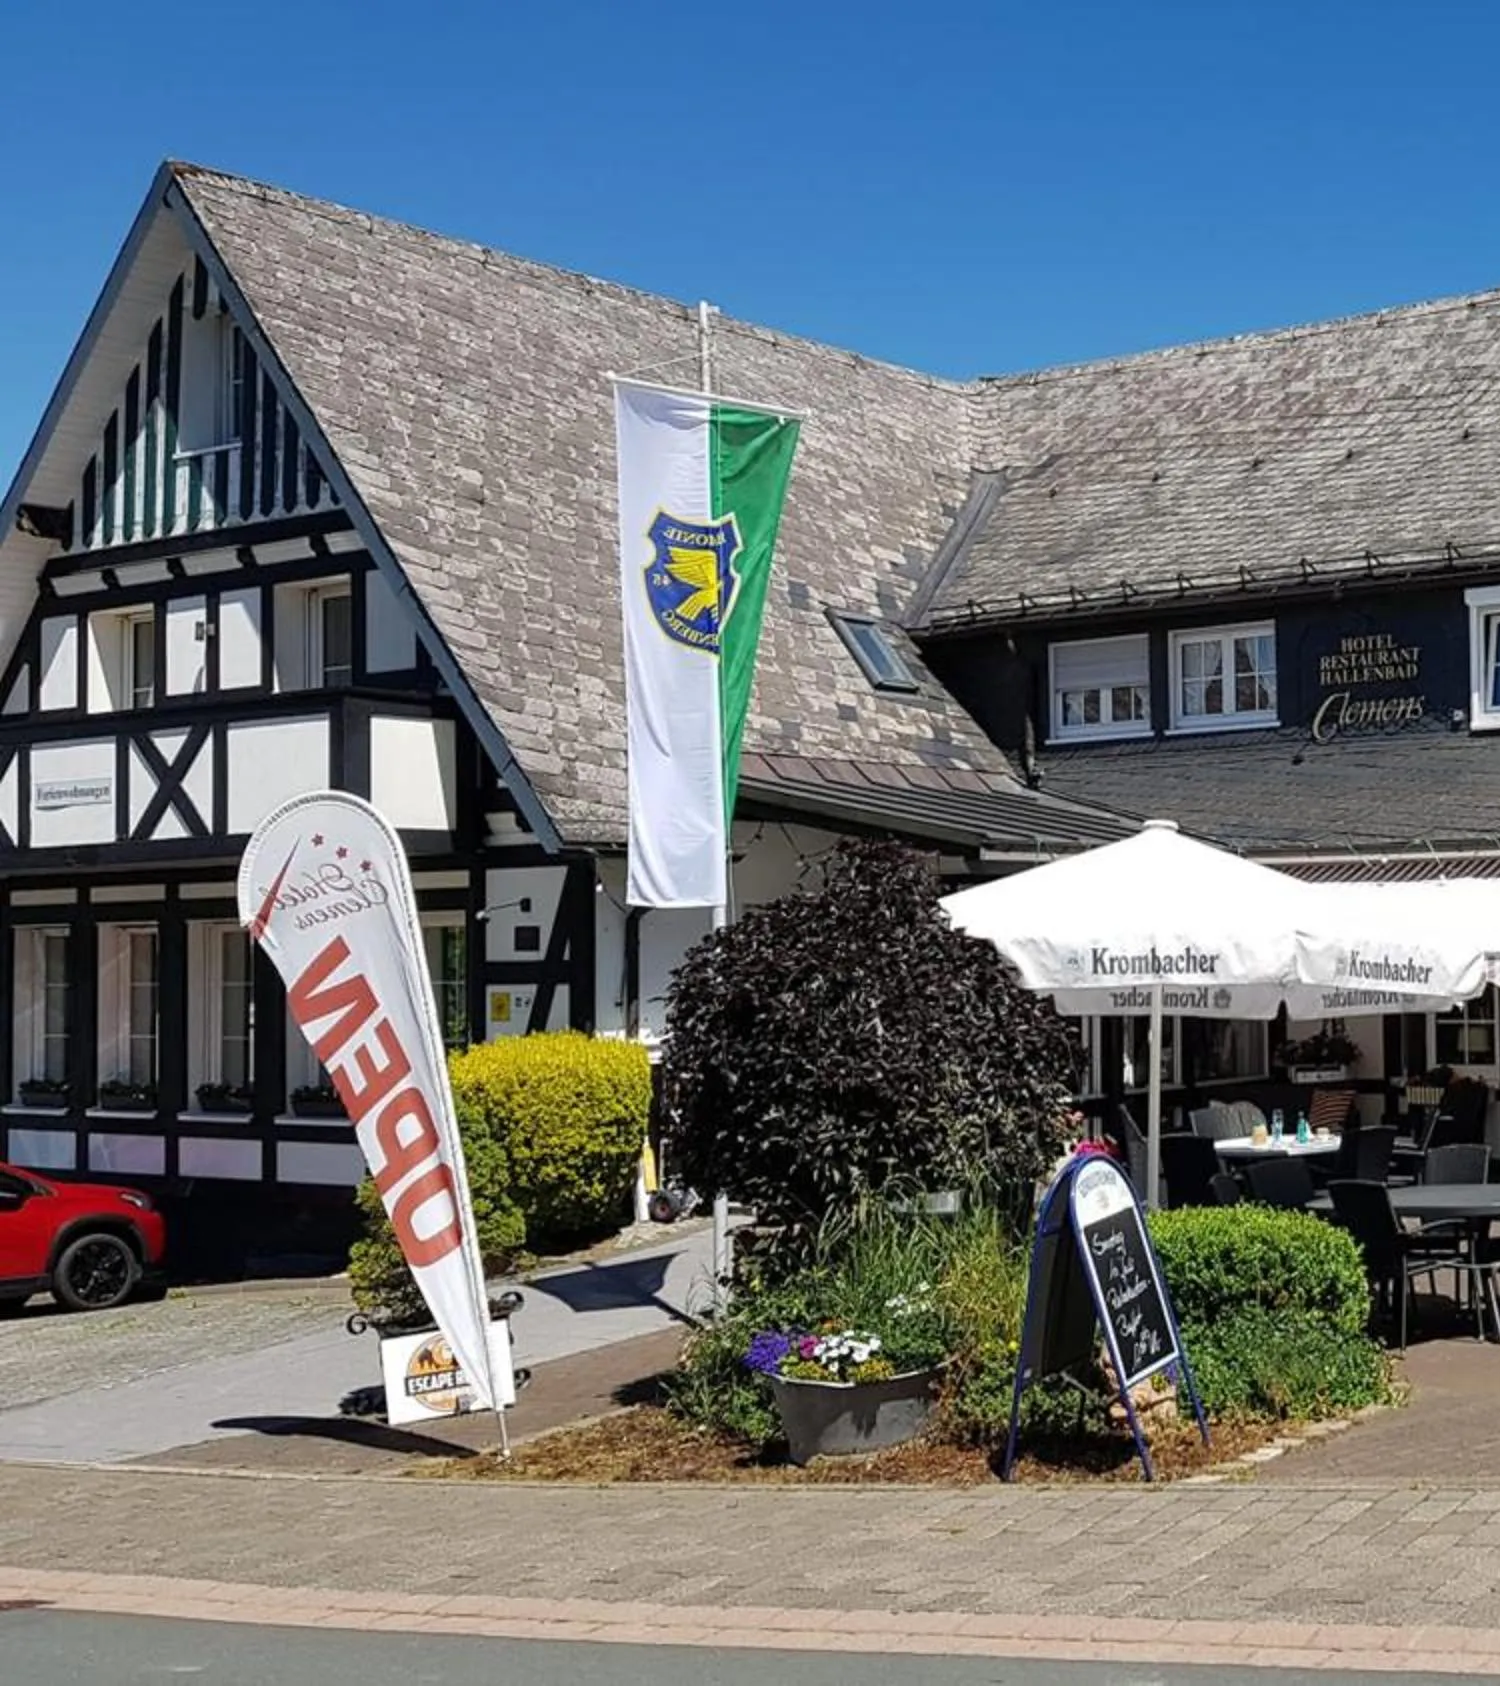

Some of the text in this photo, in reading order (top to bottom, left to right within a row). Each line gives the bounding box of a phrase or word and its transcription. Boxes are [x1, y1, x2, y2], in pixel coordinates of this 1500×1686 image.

[1341, 634, 1399, 654] HOTEL
[1319, 647, 1421, 671] RESTAURANT
[1319, 663, 1419, 687] HALLENBAD
[1312, 691, 1426, 743] Clemens
[1091, 946, 1220, 977] Krombacher
[1349, 950, 1432, 985] Krombacher
[409, 1371, 453, 1392] ESCAPE
